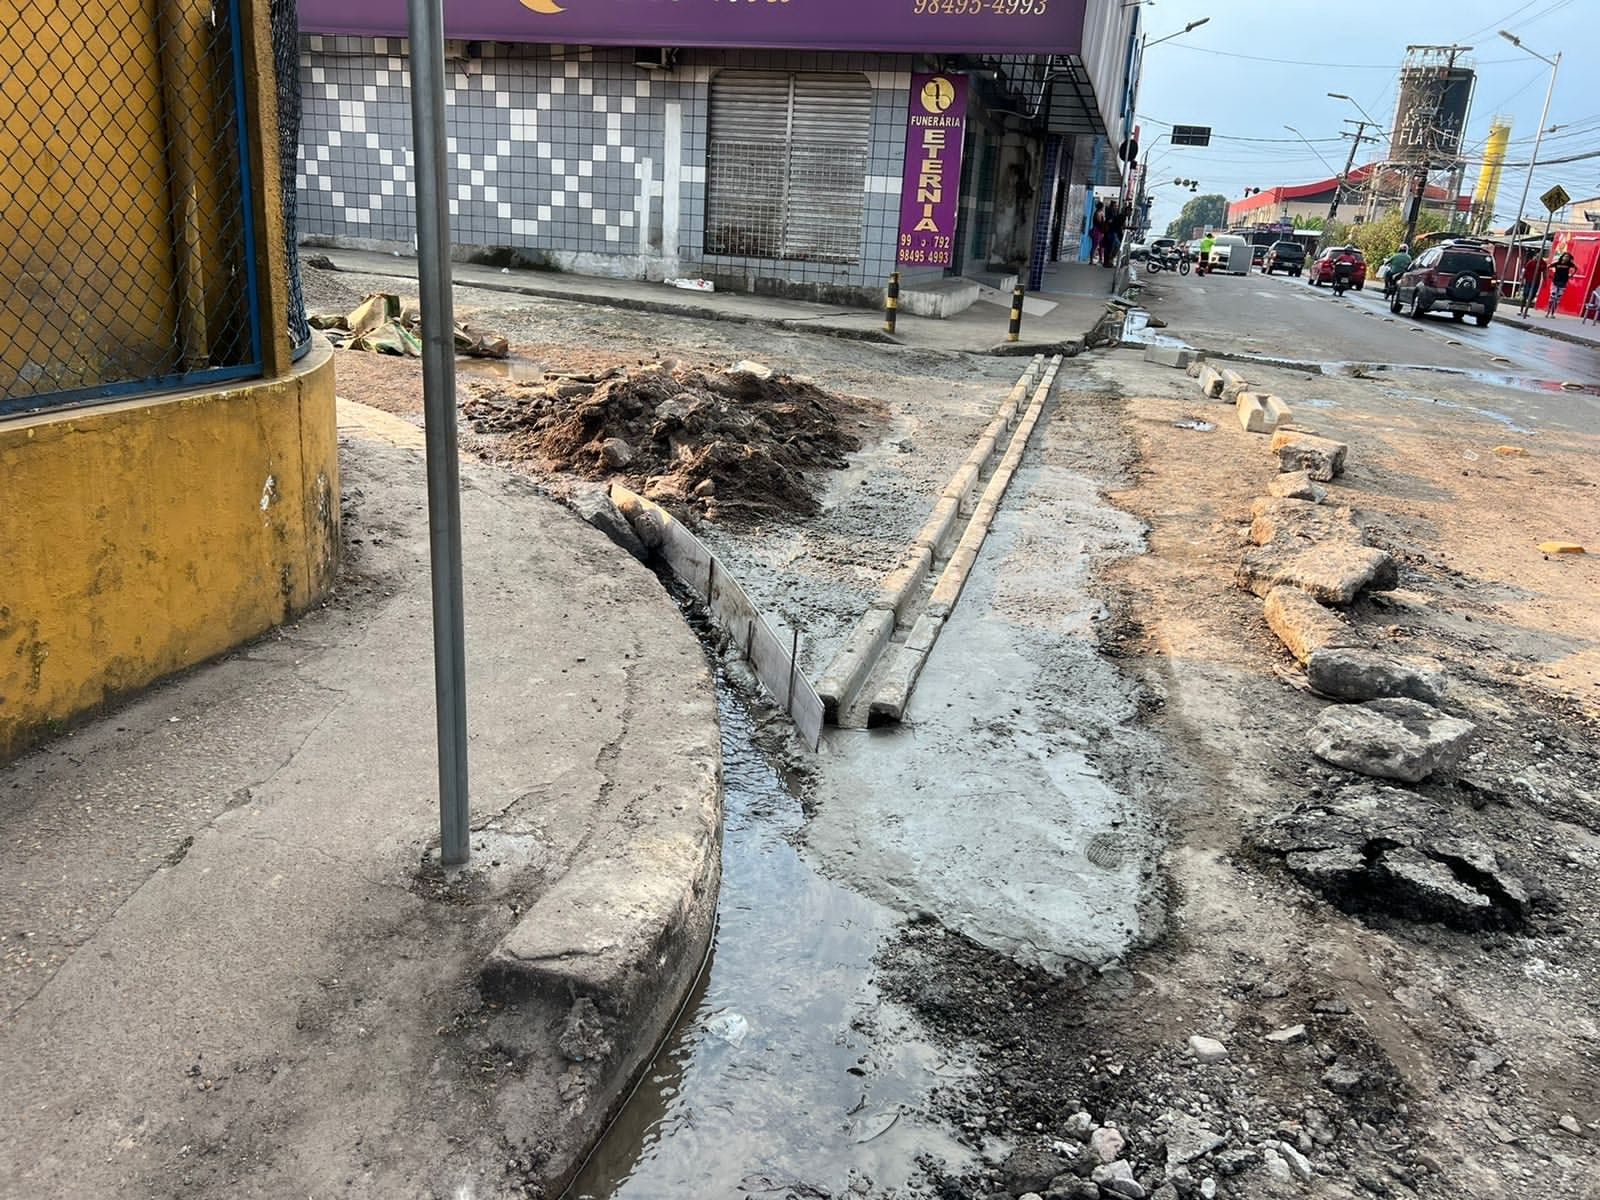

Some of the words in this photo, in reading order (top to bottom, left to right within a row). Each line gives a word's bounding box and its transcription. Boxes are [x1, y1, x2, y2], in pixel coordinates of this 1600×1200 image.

[911, 114, 960, 127] FUNERÁRIA
[913, 130, 945, 232] ETERNIA
[899, 249, 925, 263] 98495
[928, 250, 949, 264] 4993
